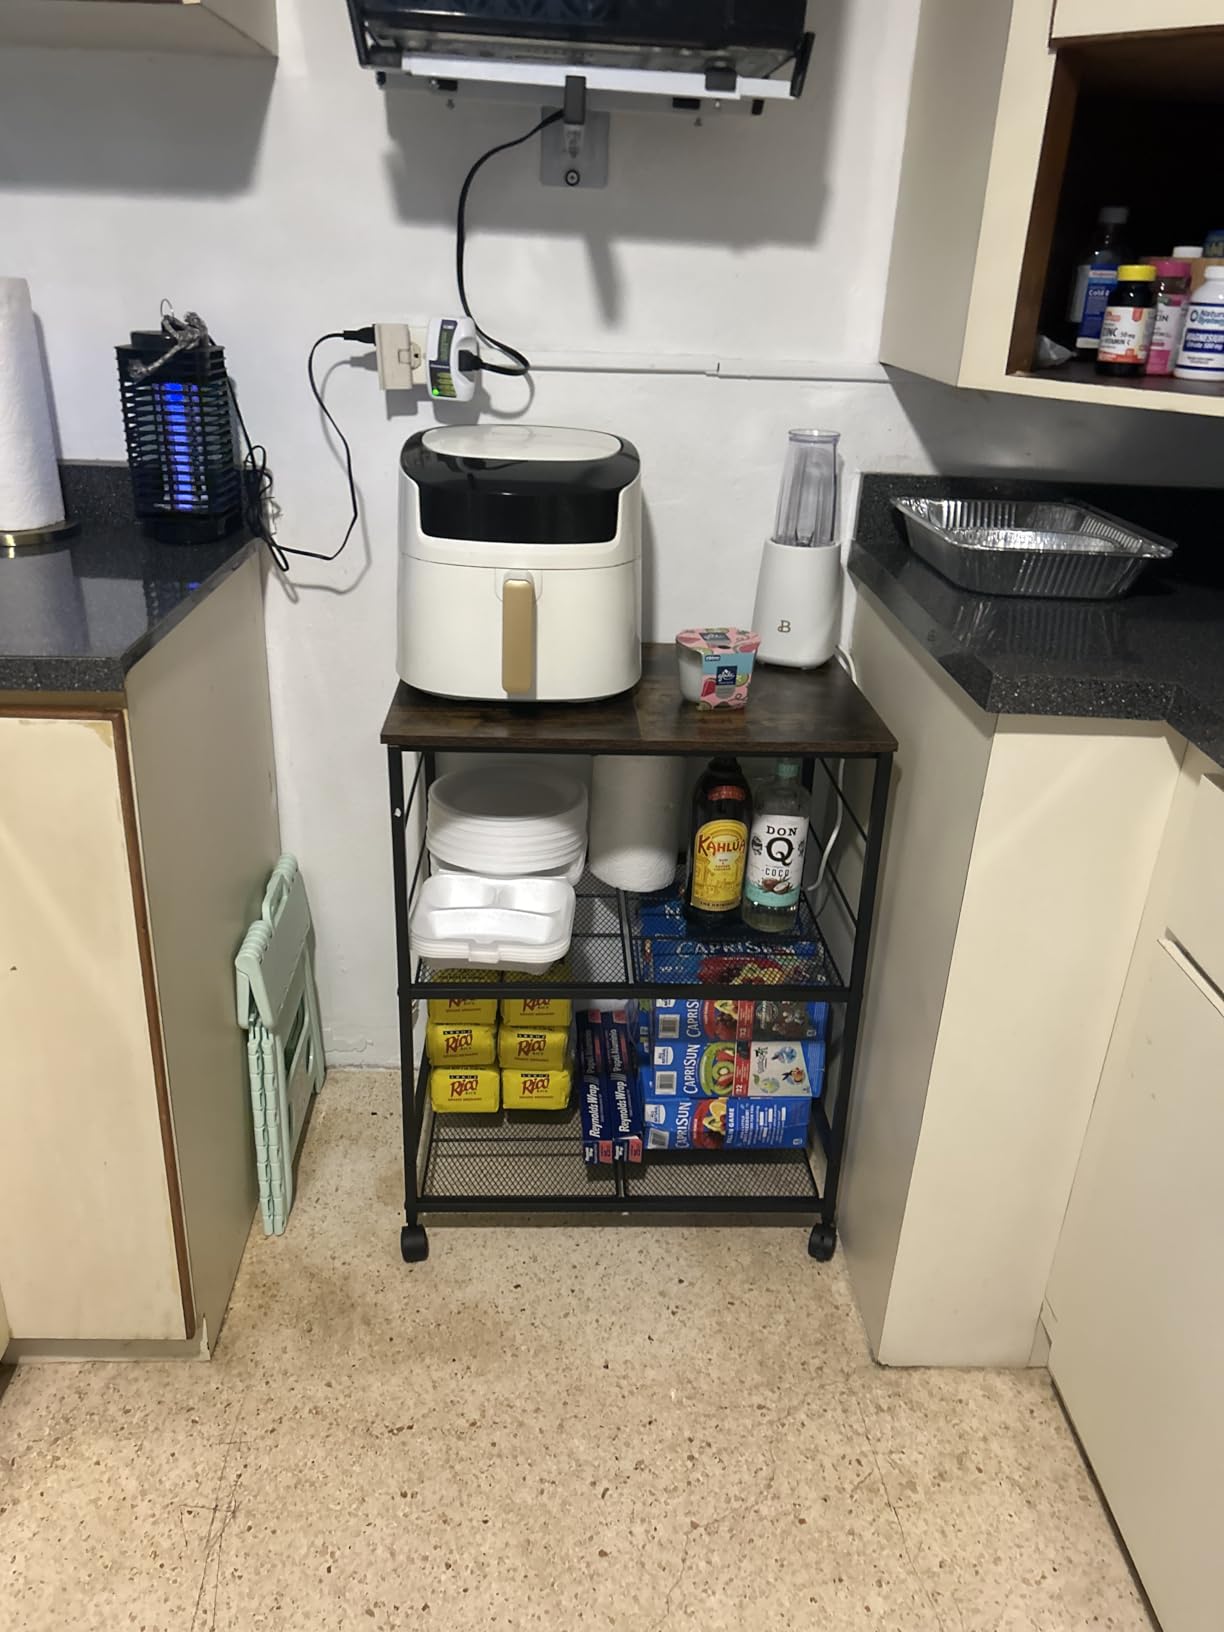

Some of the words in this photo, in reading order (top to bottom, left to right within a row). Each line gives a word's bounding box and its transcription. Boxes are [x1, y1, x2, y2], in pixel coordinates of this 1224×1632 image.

[1088, 289, 1105, 297] Cold
[766, 825, 798, 836] DON
[698, 833, 746, 856] KAHLÚA
[765, 837, 795, 866] Q
[765, 867, 790, 877] COCO
[686, 999, 700, 1038] CAPRIS
[445, 1034, 473, 1054] Rico
[518, 1039, 546, 1057] Rico
[683, 1044, 701, 1094] CAPRISUN
[450, 1079, 479, 1097] Rico
[522, 1077, 550, 1095] Rico
[587, 1083, 600, 1104] Wrap
[615, 1081, 627, 1101] Wrap
[588, 1102, 603, 1138] Reynolds
[618, 1099, 632, 1133] Reynolds
[675, 1102, 692, 1149] CAPRISUN
